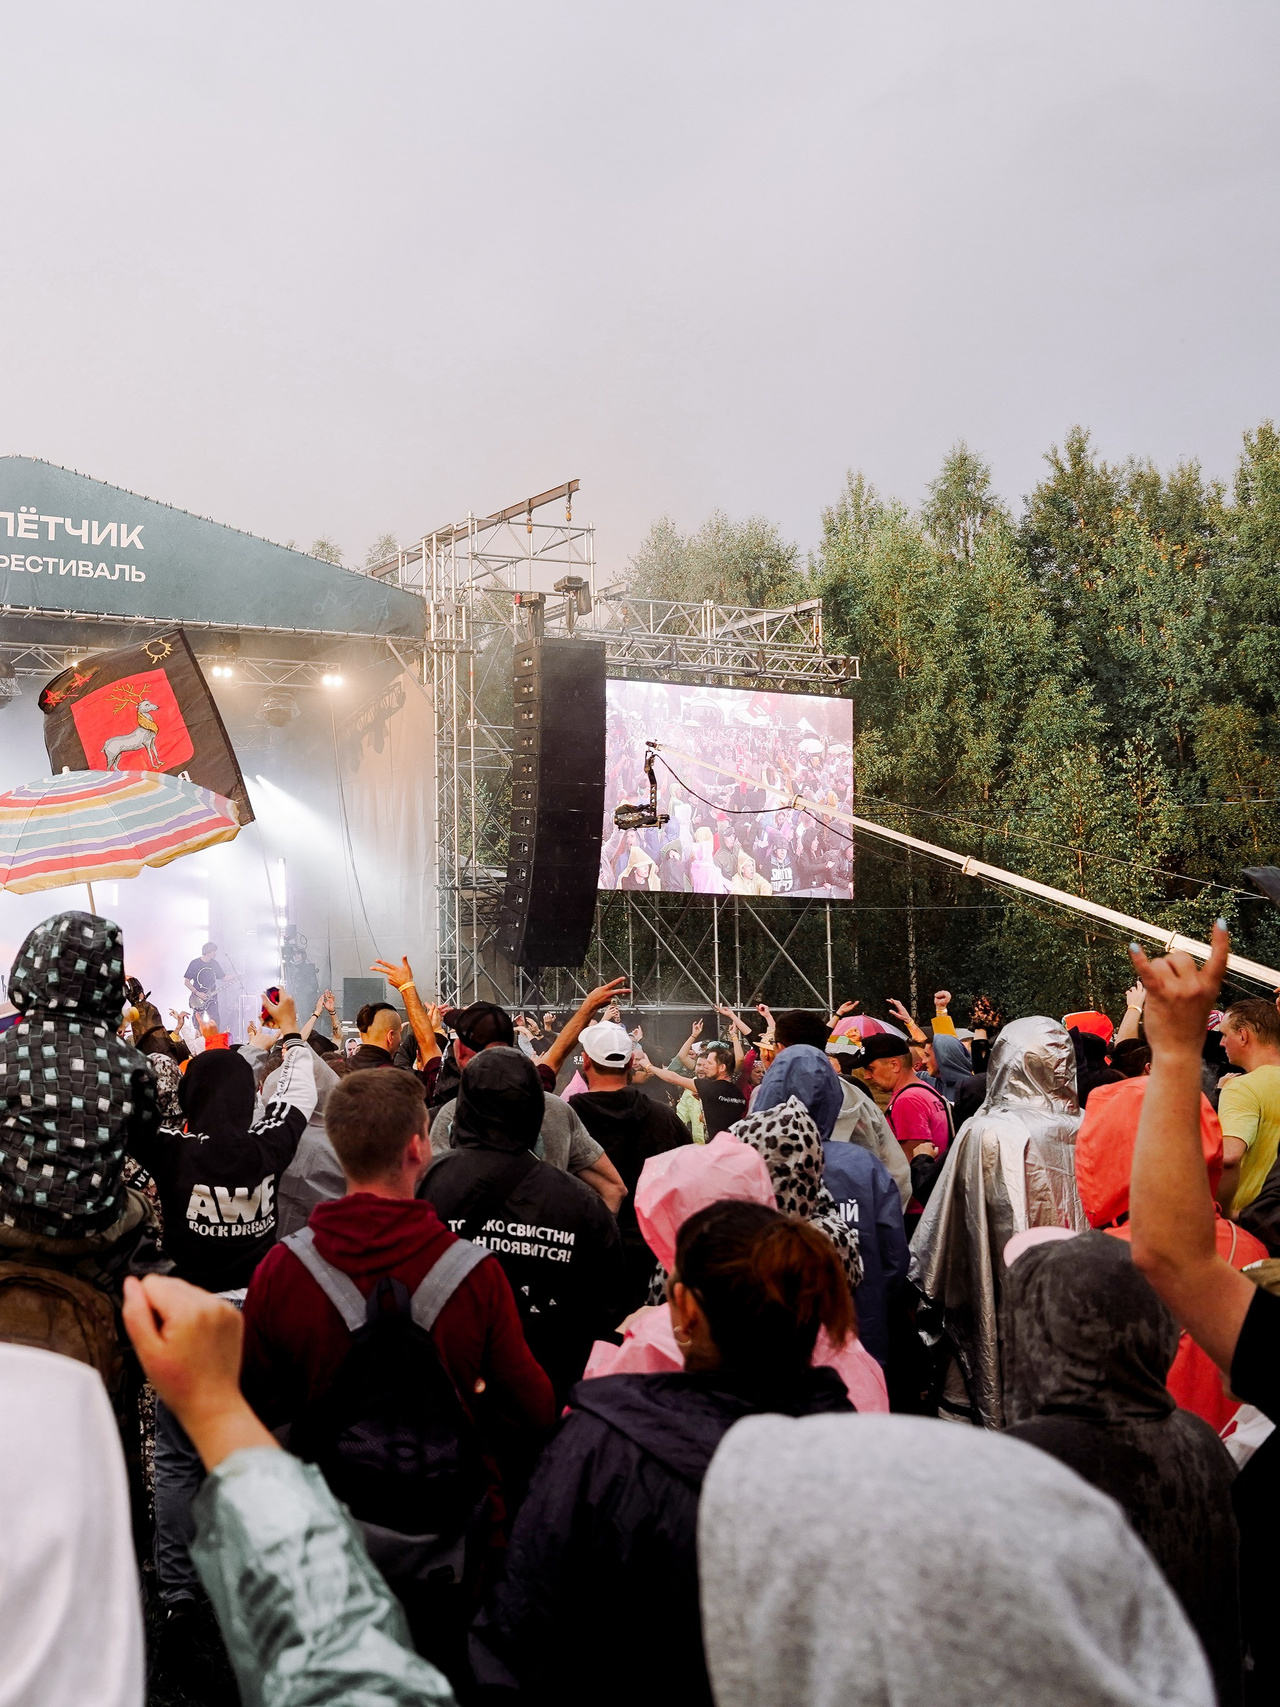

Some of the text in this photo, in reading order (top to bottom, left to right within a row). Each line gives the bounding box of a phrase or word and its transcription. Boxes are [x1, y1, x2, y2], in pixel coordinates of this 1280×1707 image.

[186, 1173, 275, 1223] AWE
[188, 1220, 229, 1237] ROCK
[507, 1222, 575, 1246] СВИСТНИ
[490, 1237, 572, 1263] ПОЯВИТСЯ!
